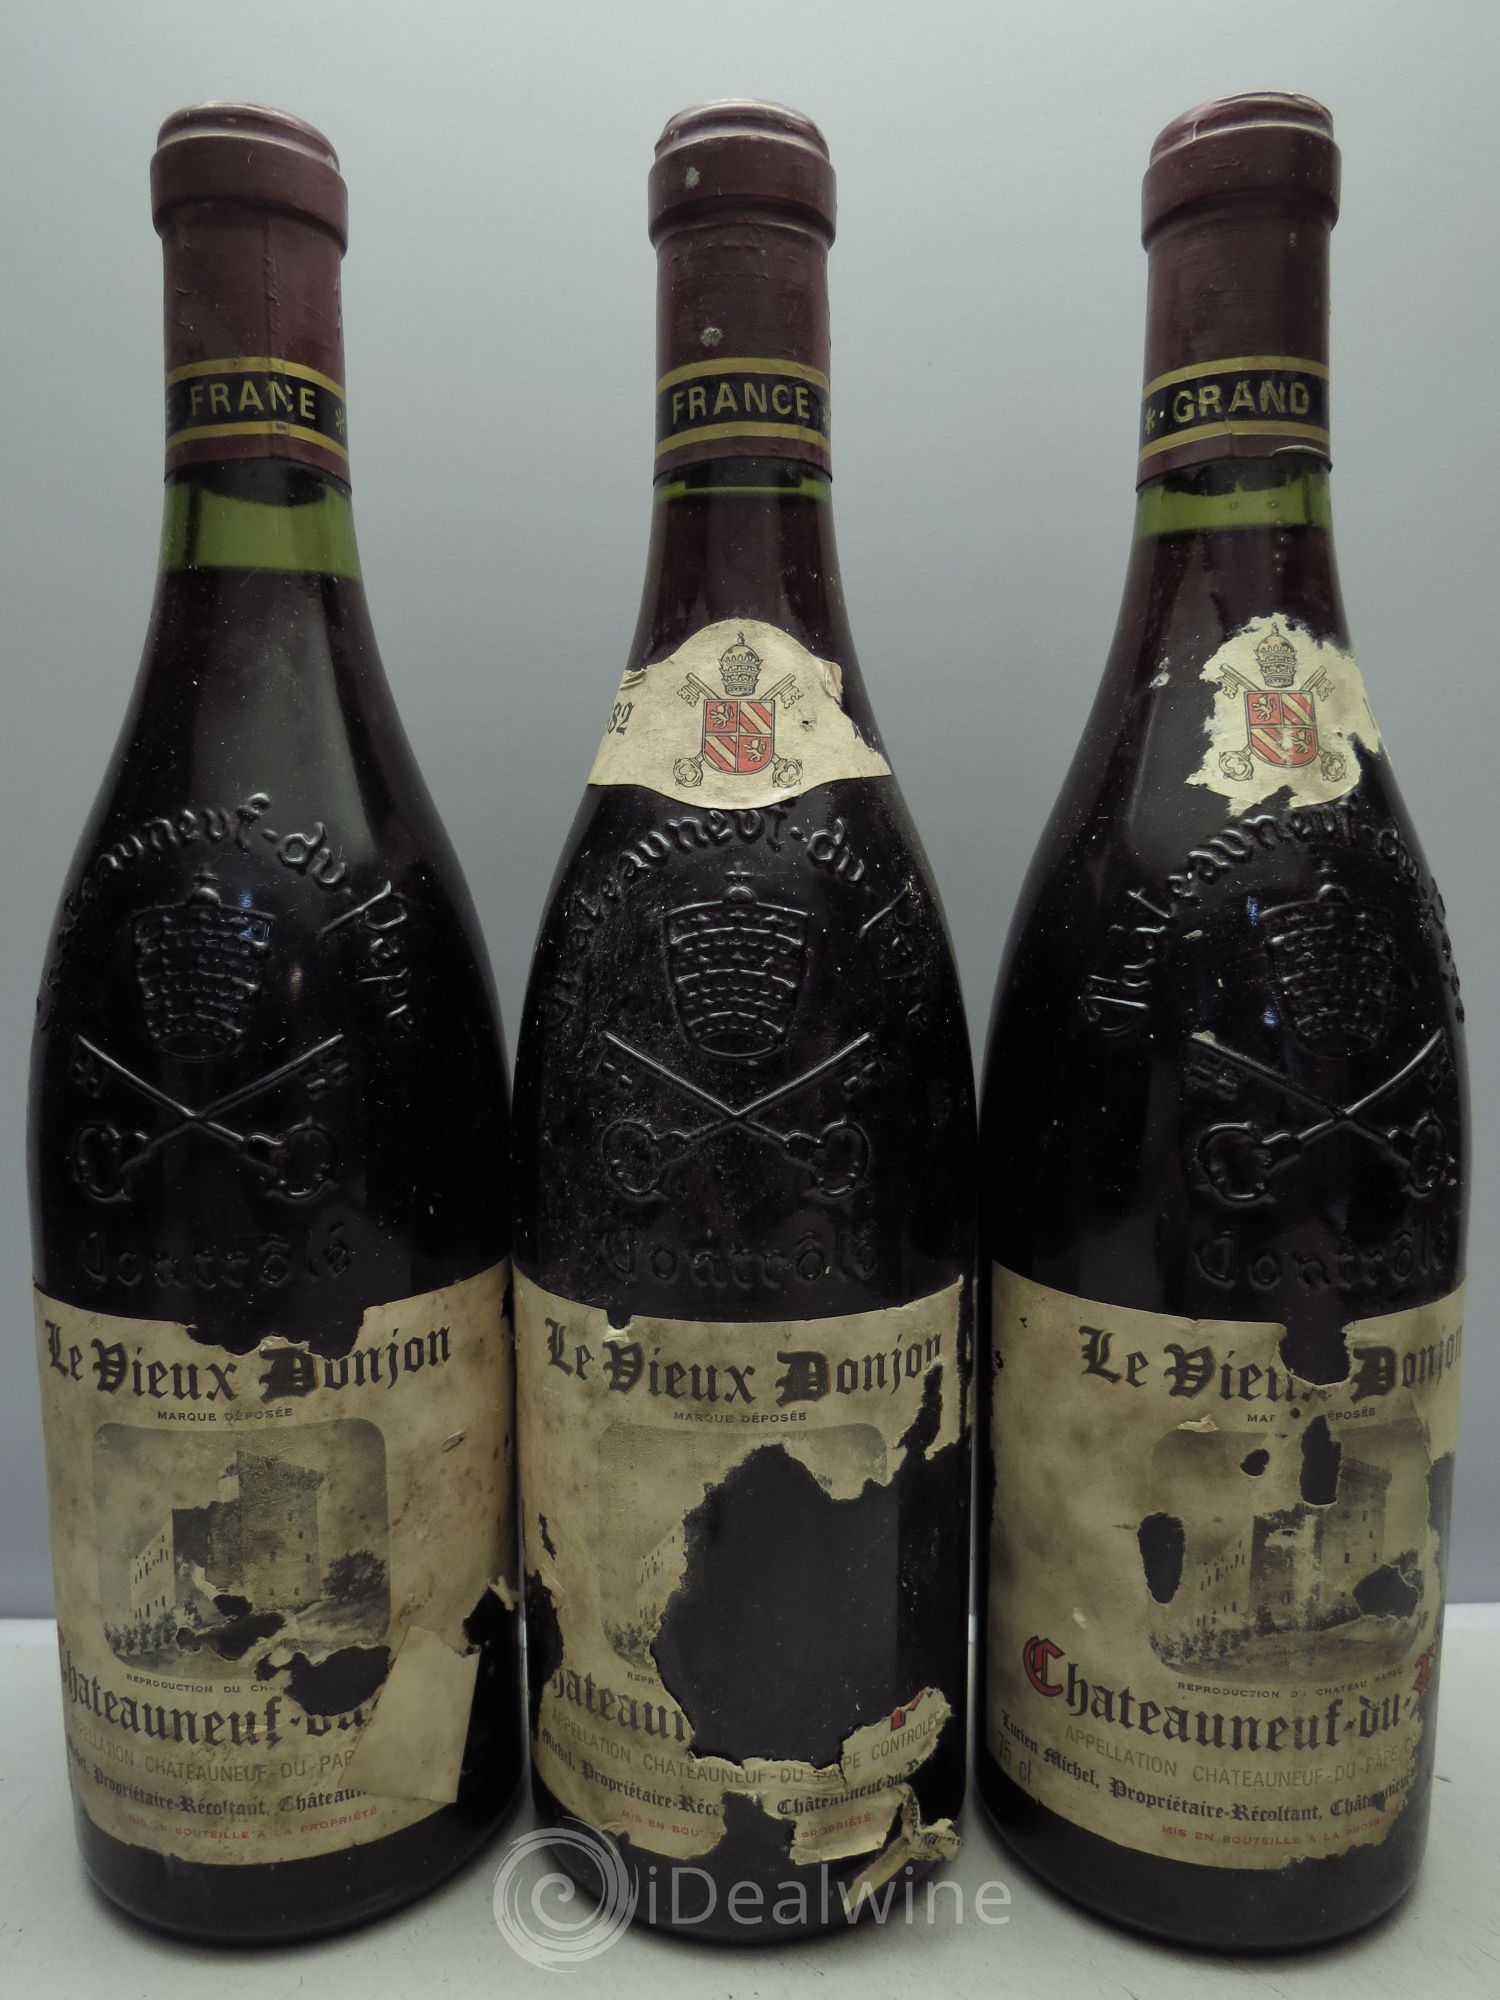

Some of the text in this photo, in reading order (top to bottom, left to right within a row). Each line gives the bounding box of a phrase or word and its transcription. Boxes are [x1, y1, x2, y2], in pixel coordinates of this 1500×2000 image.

[672, 382, 810, 425] FRANCE
[1172, 379, 1311, 424] GRAND
[45, 1319, 452, 1404] Le Vieux Donjon
[544, 1316, 942, 1408] Le Vieux Donjon
[1078, 1324, 1463, 1404] Le Vieu Donjon
[157, 1406, 294, 1422] MARQUE DÉPOSÉE
[673, 1408, 808, 1424] MARQUE DÉPOSÉE
[125, 1672, 213, 1694] REPRODUCTION
[223, 1685, 240, 1693] DU
[1177, 1681, 1280, 1700] REPRODUCTION
[552, 1708, 632, 1764] APPELLATION
[1065, 1725, 1398, 1788] APPELLATION CHATEAUNEUF-DU-PAPE
[1000, 1709, 1039, 1754] Lucien
[1043, 1747, 1100, 1789] Michel,
[1109, 1776, 1323, 1823] Propriétaire-Récoltant,
[174, 1826, 250, 1840] BOUTEILLE
[621, 1809, 643, 1824] MIS
[648, 1818, 665, 1830] EN
[1161, 1824, 1188, 1837] MIS
[1194, 1831, 1213, 1841] EN
[1222, 1834, 1302, 1846] BOUTEILLE
[1323, 1831, 1340, 1841] LA
